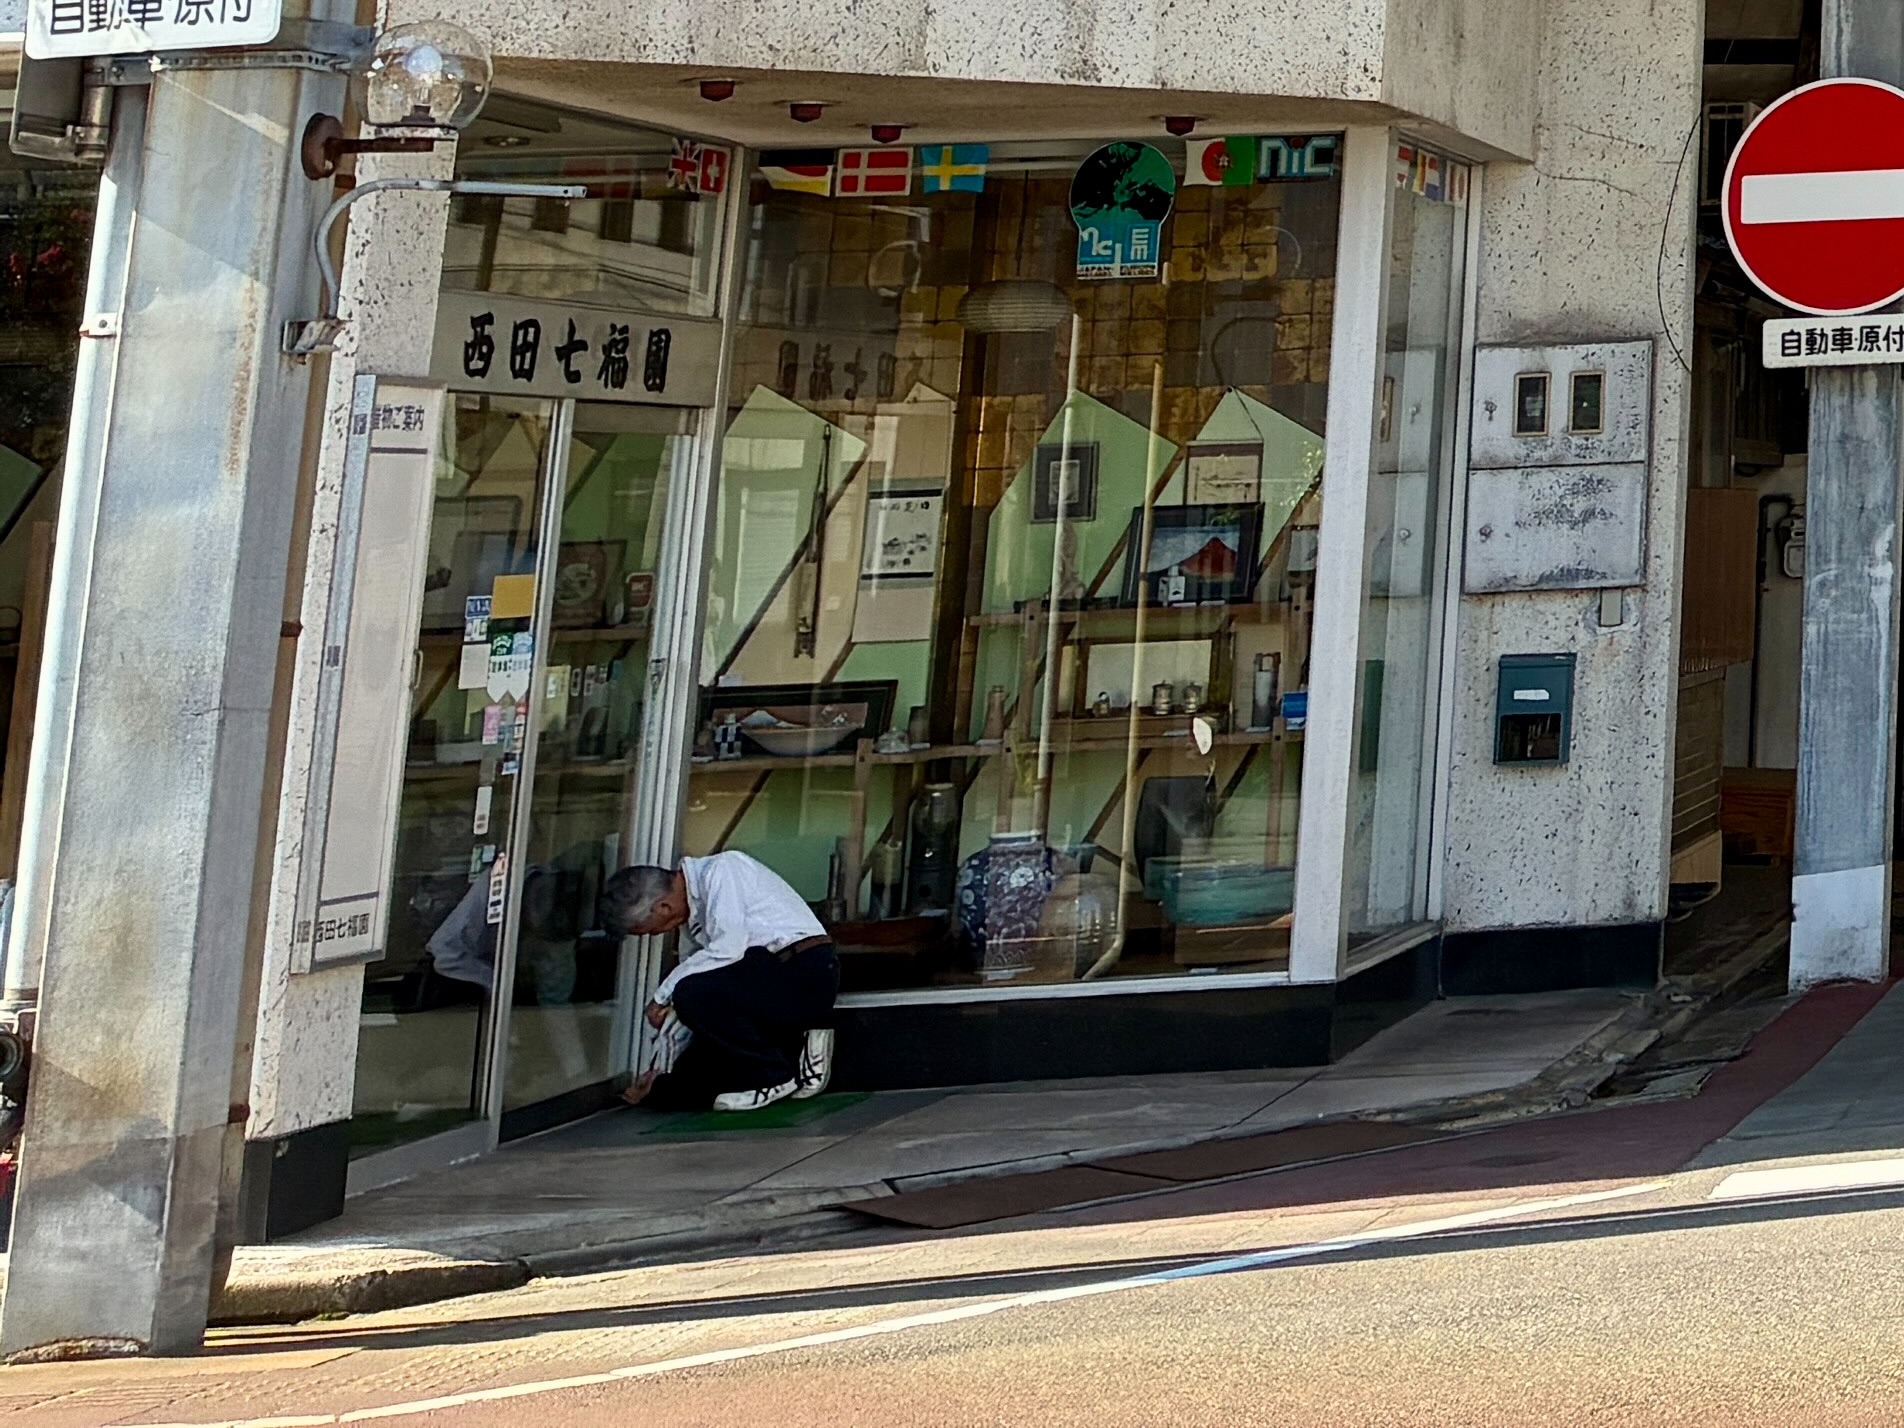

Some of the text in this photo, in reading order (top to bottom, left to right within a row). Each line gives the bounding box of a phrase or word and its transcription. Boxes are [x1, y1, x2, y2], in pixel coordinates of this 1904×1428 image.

[463, 311, 672, 394] 西田七福園
